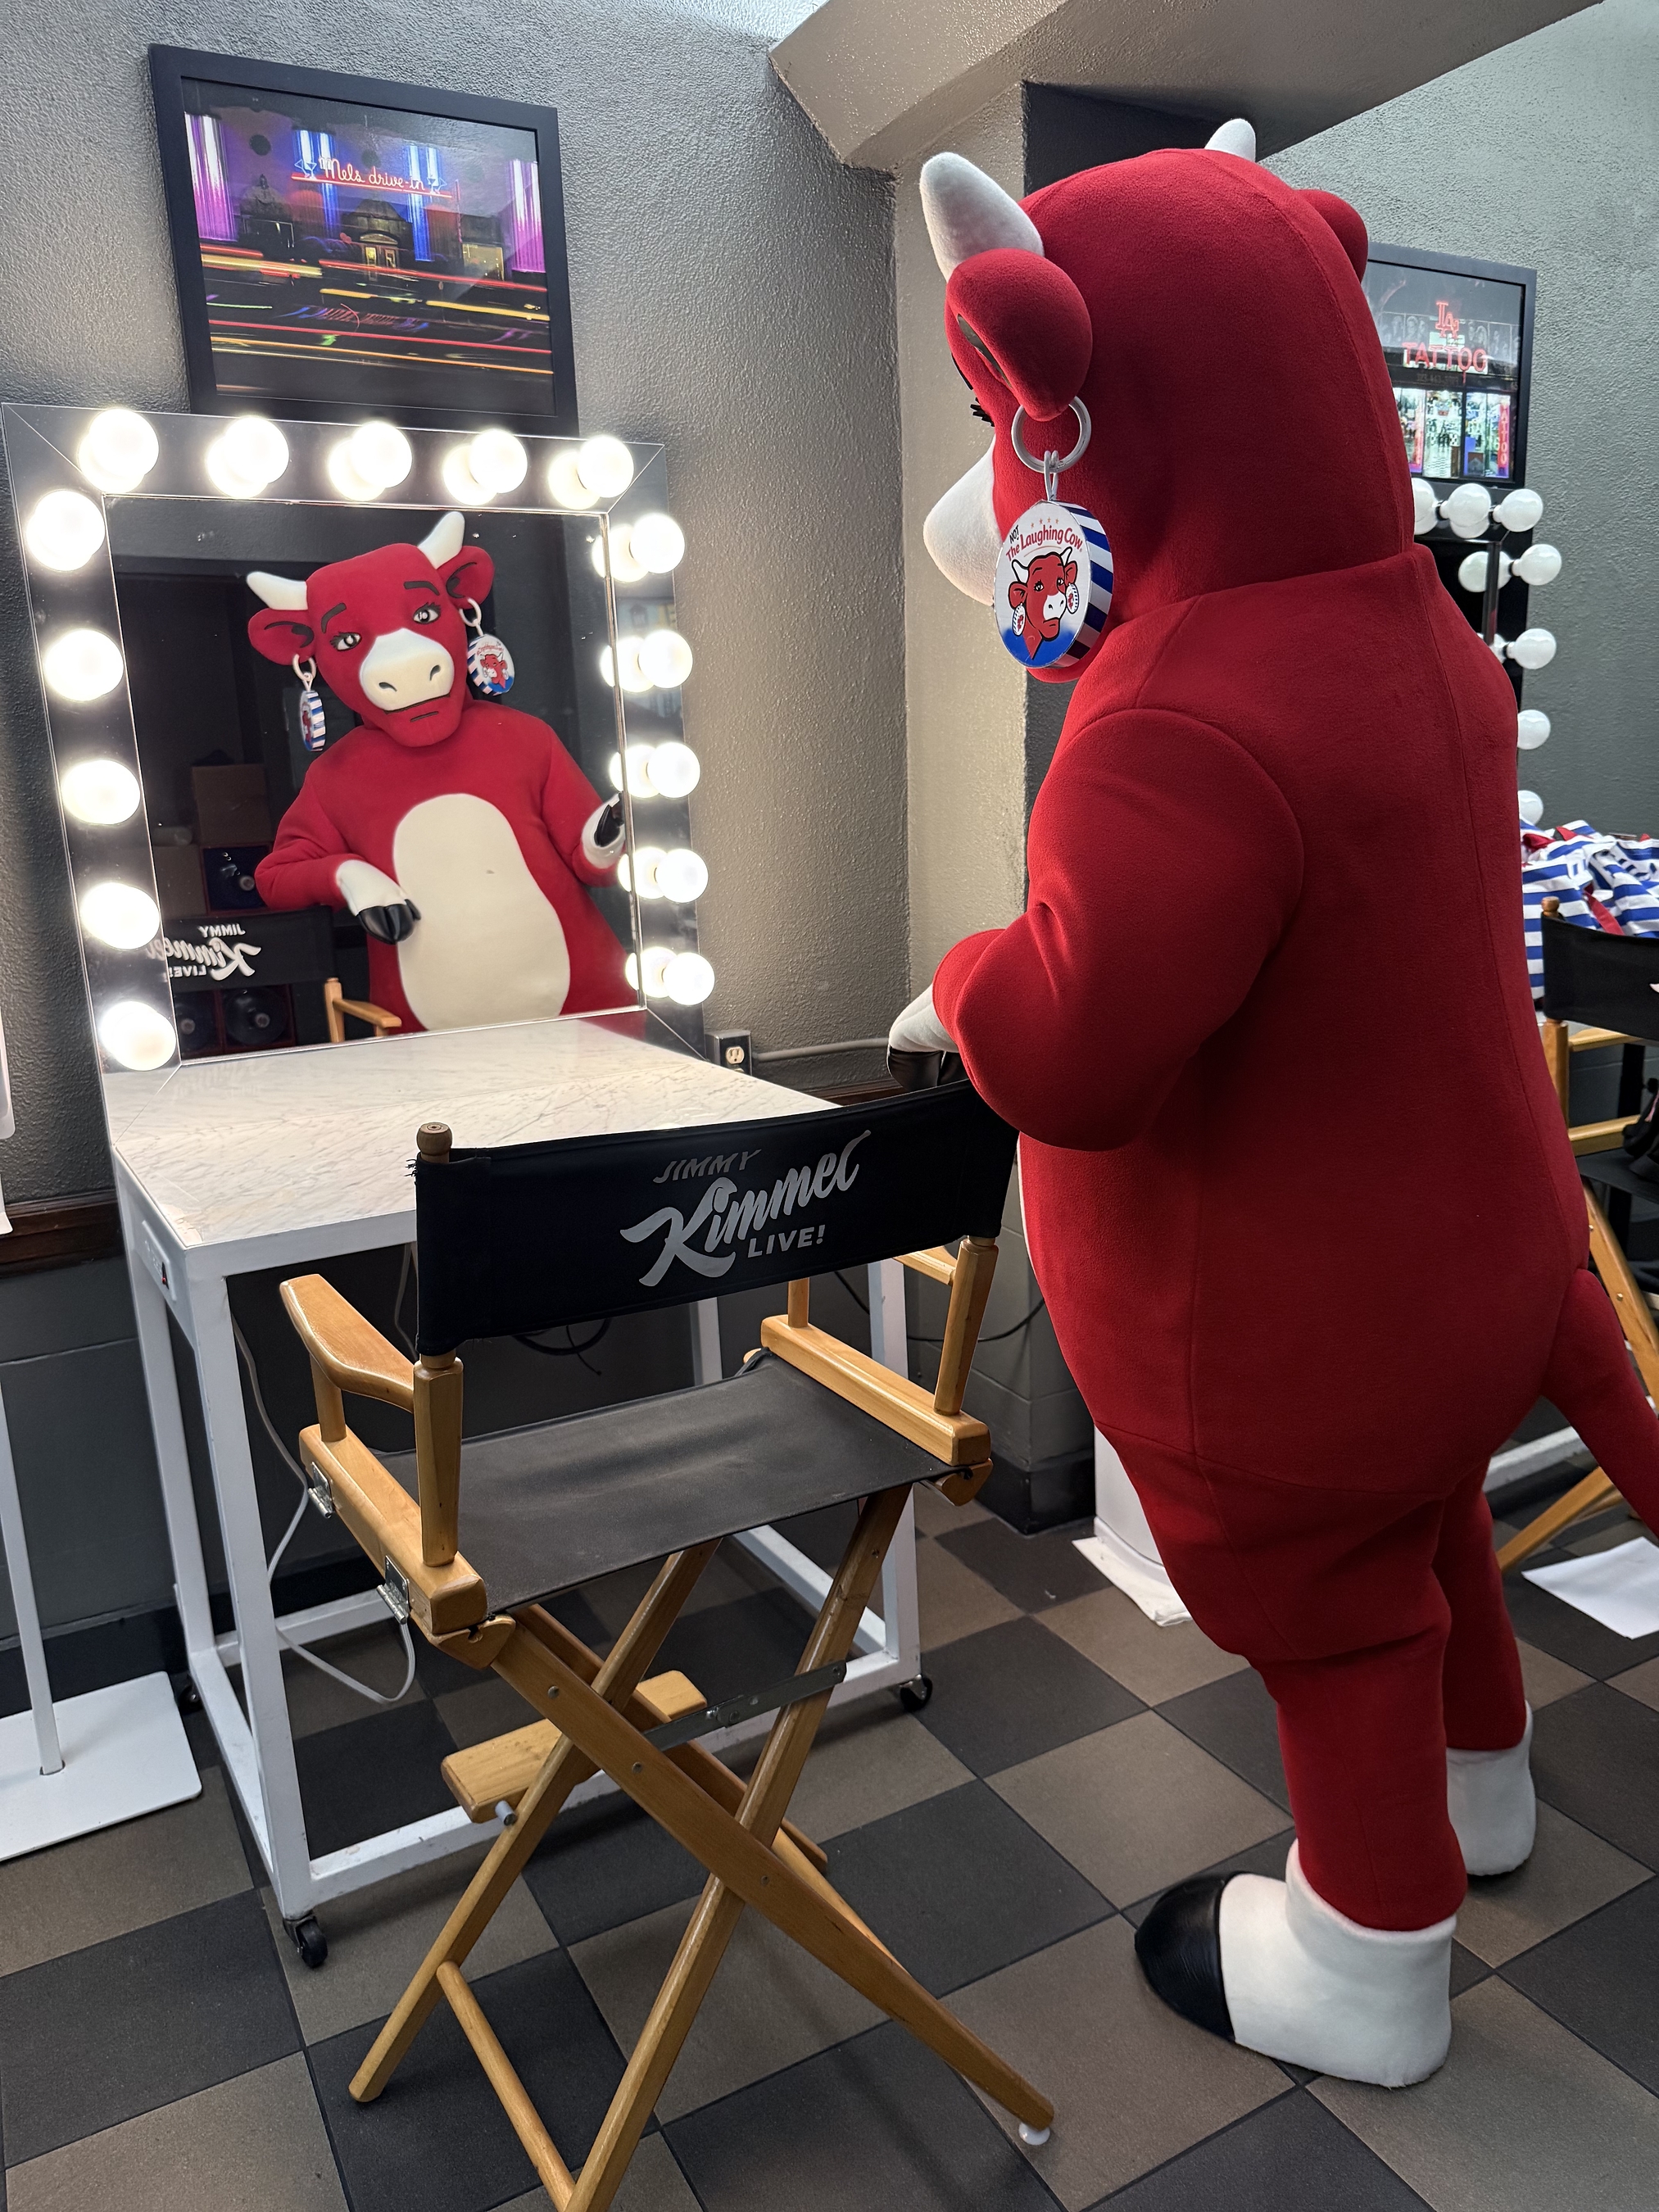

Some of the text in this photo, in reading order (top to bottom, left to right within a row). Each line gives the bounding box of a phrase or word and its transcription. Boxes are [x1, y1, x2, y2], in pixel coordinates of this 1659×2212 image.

[318, 156, 425, 190] Mels drive-in
[1435, 301, 1459, 339] LA
[1402, 342, 1488, 373] TATTOO
[1006, 524, 1083, 562] The Laughing Cow
[653, 1149, 762, 1184] JIMMY
[619, 1130, 872, 1287] Kimmel
[747, 1224, 826, 1258] LIVE!
